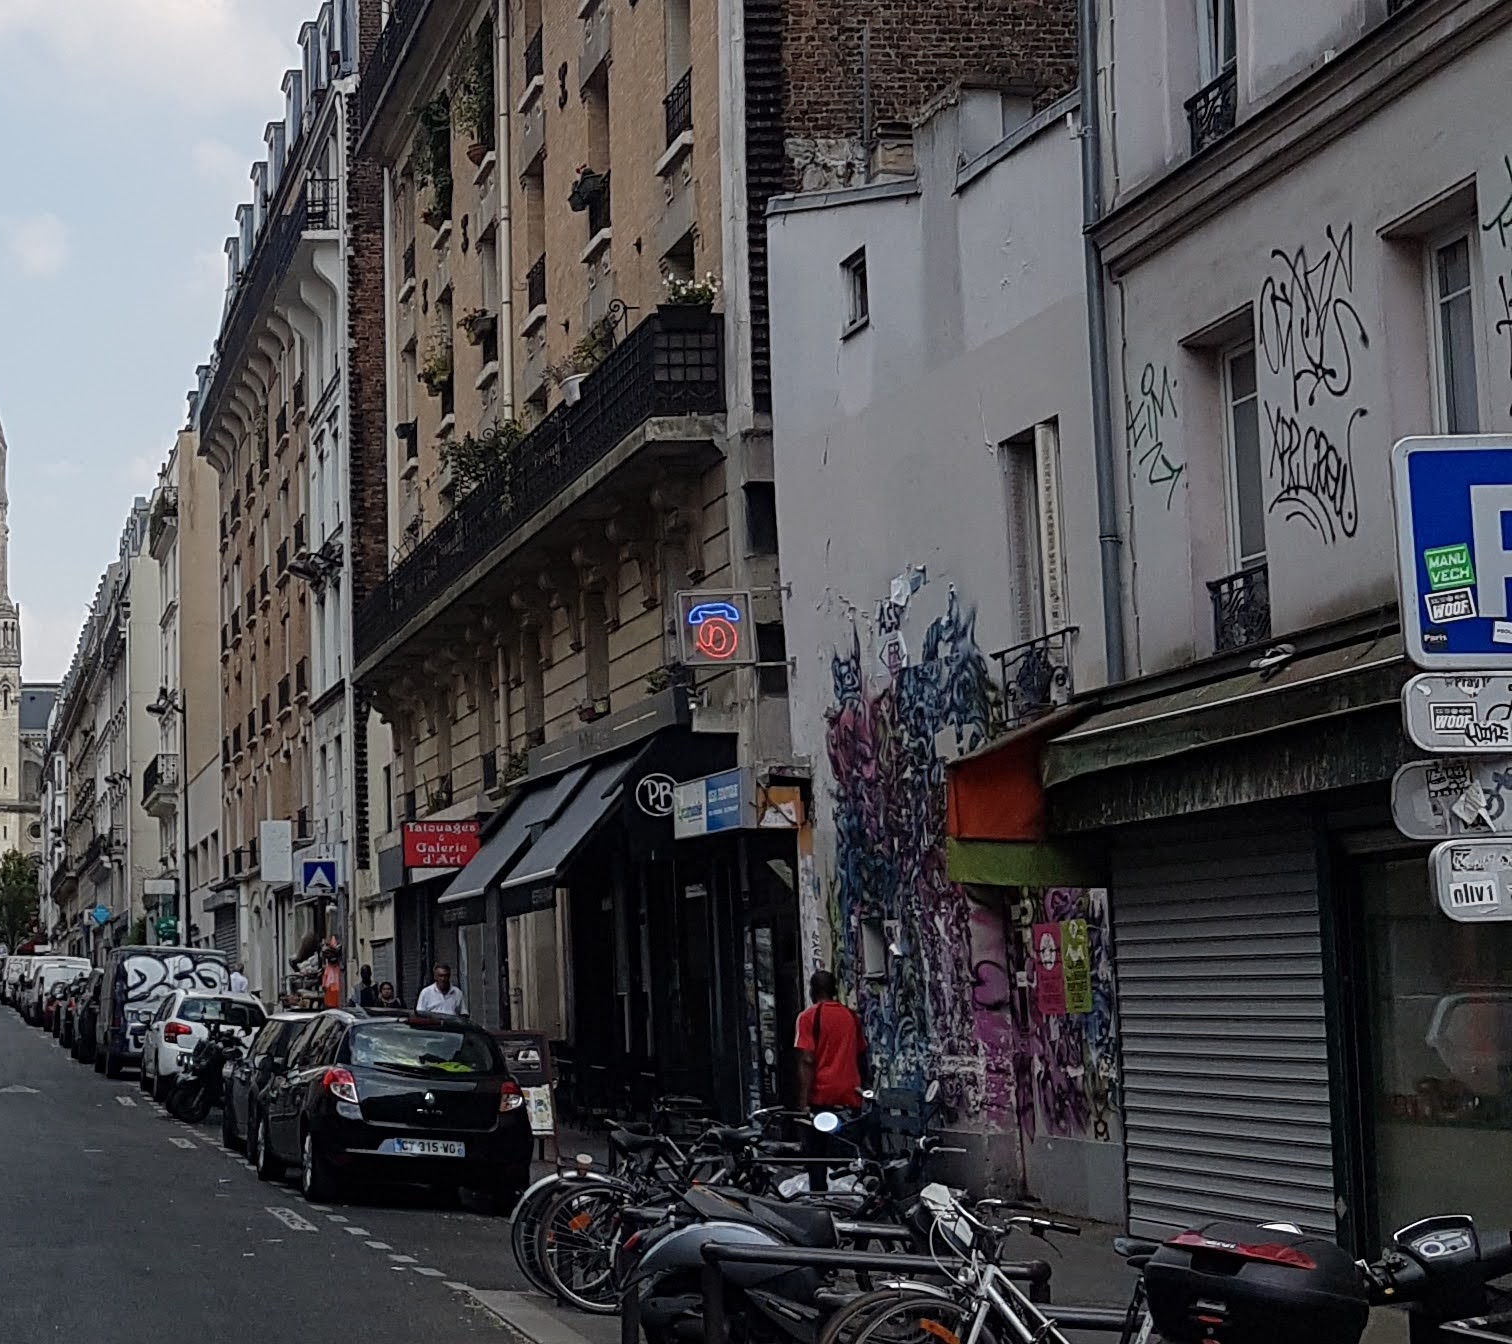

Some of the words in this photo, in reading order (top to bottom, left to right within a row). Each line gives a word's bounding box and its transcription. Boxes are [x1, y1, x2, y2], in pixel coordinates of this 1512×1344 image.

[1429, 551, 1467, 570] MANU
[1431, 567, 1470, 585] VECH
[1432, 601, 1470, 620] WOOF
[408, 823, 476, 834] Tatouages
[416, 842, 467, 853] Galerie
[423, 854, 461, 864] d'Art
